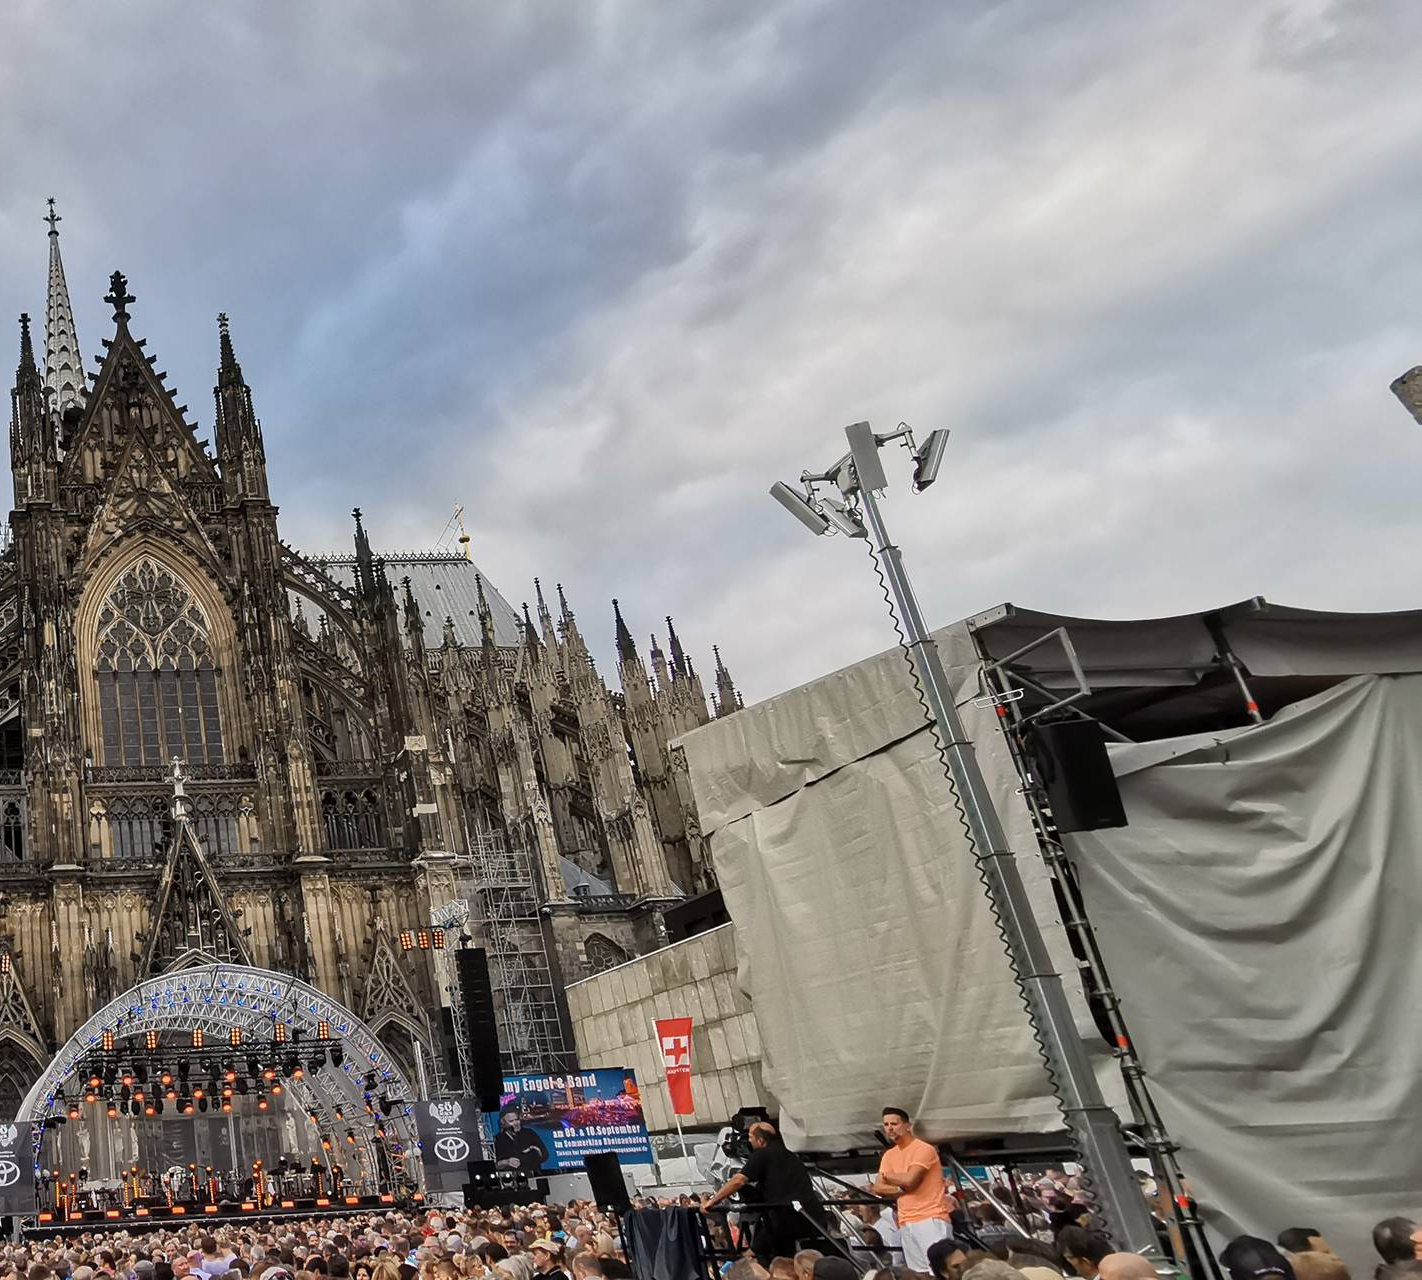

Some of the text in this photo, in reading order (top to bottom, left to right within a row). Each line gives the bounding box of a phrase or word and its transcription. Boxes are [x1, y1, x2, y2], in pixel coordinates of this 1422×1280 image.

[522, 1076, 555, 1092] Engel
[556, 1077, 565, 1089] &
[566, 1073, 597, 1088] Band
[553, 1130, 564, 1138] am
[565, 1127, 579, 1138] 09.
[564, 1138, 603, 1148] Sommerkino
